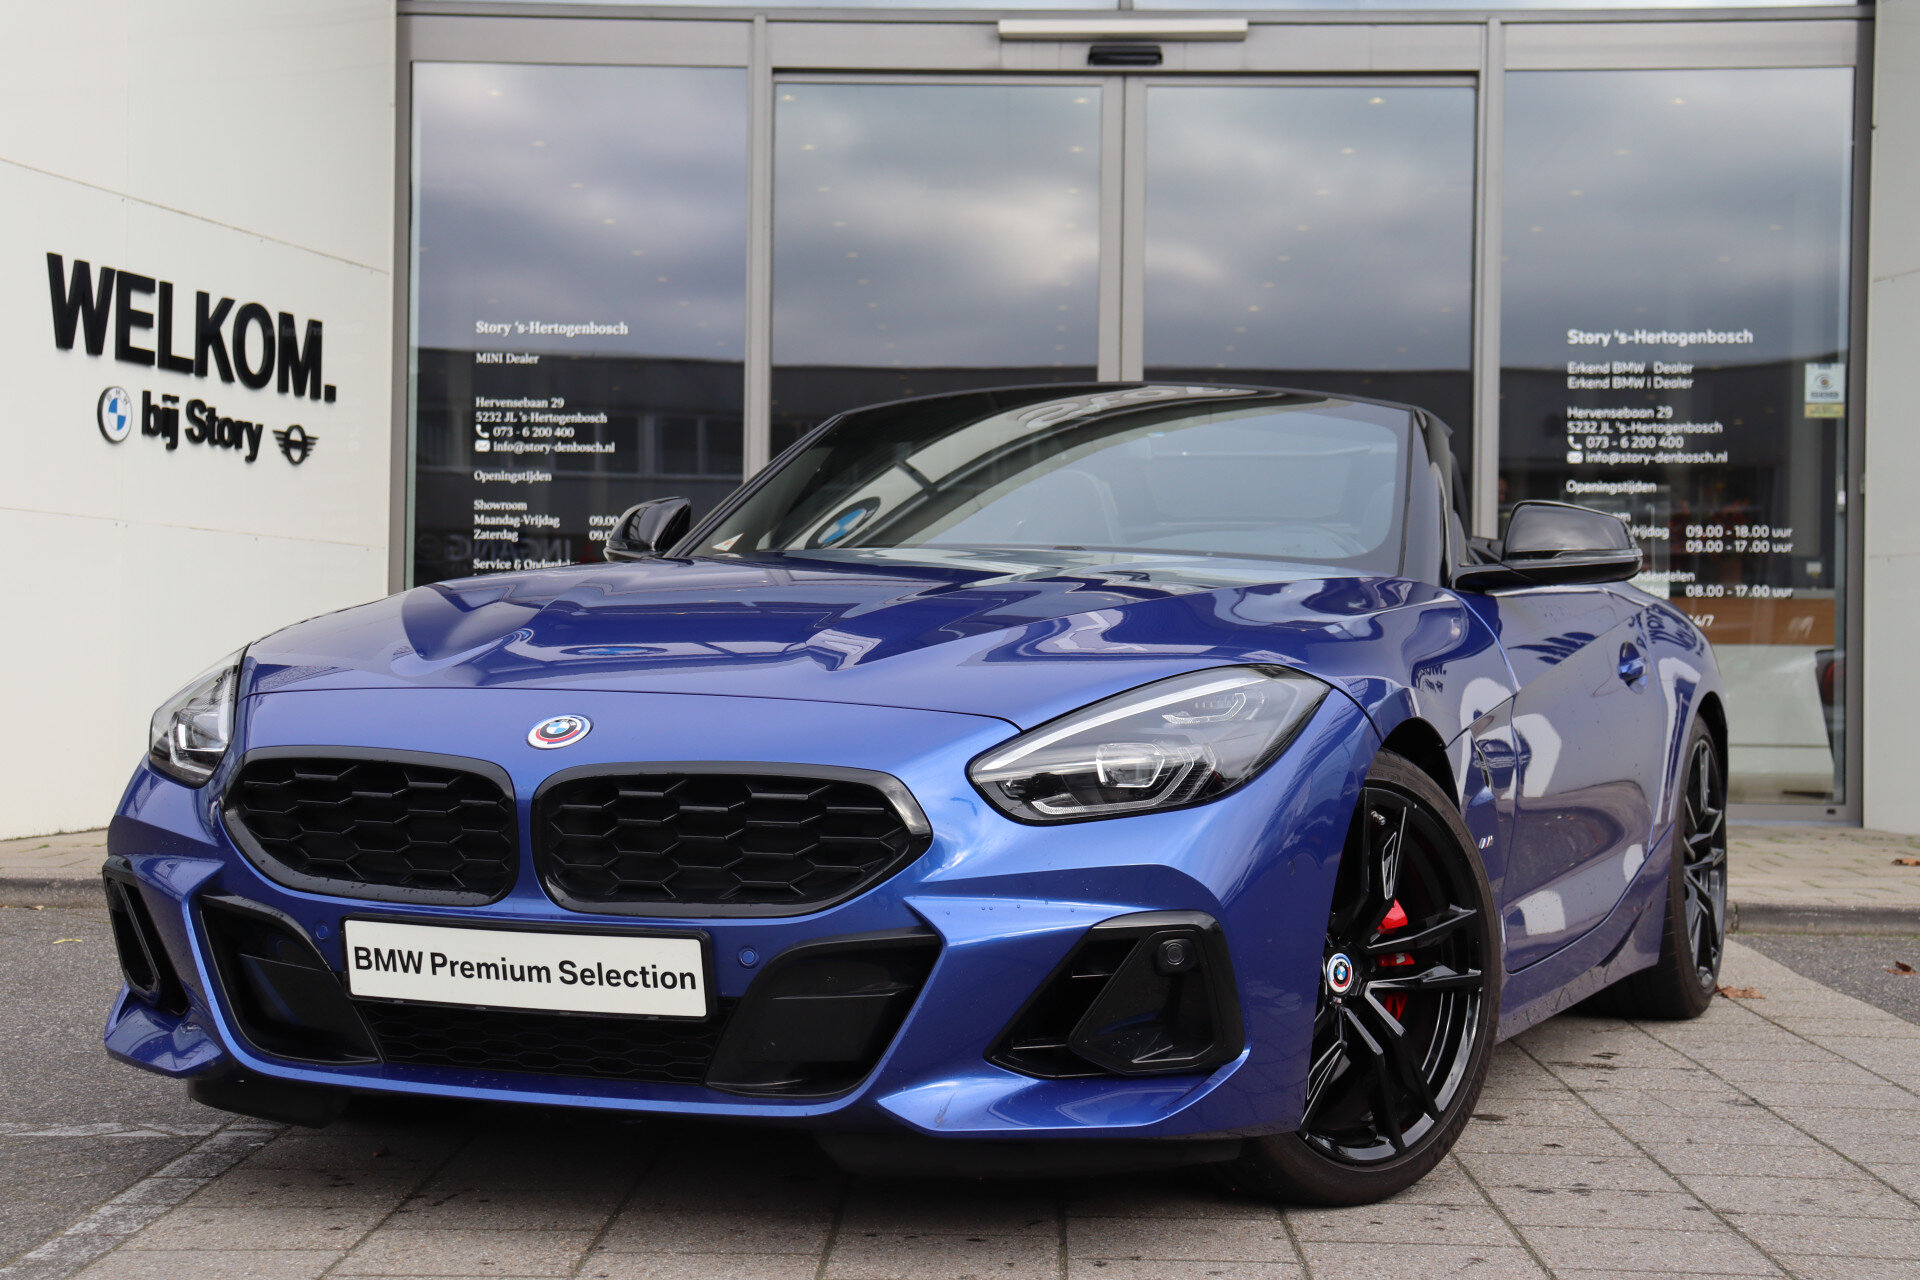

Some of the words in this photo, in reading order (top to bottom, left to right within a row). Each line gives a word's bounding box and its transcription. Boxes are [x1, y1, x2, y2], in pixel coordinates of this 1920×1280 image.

[46, 252, 337, 403] WELKOM.
[475, 320, 512, 337] Story
[1567, 328, 1612, 347] Story
[475, 353, 503, 364] MINI
[505, 353, 540, 364] Dealer
[1567, 361, 1610, 374] Erkend
[1612, 361, 1645, 374] BMW
[1653, 361, 1694, 374] Dealer
[1567, 376, 1610, 389] Erkend
[1612, 376, 1645, 389] BMW
[1653, 376, 1694, 389] Dealer
[475, 397, 549, 409] Hervensebaan
[551, 397, 565, 409] 29
[475, 411, 502, 423] 5232
[503, 412, 517, 423] JL
[1567, 406, 1655, 419] Hervensebaan
[1656, 406, 1673, 419] 29
[141, 390, 180, 452] bij
[184, 398, 264, 464] Story
[493, 427, 514, 438] 073
[522, 427, 530, 438] 6
[532, 427, 553, 438] 200
[554, 427, 575, 438] 400
[1567, 421, 1598, 434] 5232
[1599, 421, 1613, 434] JL
[1586, 436, 1610, 449] 073
[1620, 436, 1629, 449] 6
[1631, 436, 1657, 449] 200
[1658, 436, 1684, 449] 400
[474, 469, 552, 484] Openingstijden
[1566, 479, 1657, 495] Openingstijden
[474, 499, 528, 511] Showroom
[474, 514, 560, 528] Maandag-Vrijdag
[473, 529, 519, 543] Zaterdag
[1685, 524, 1724, 538] 09.00
[1734, 524, 1770, 538] 18.00
[1771, 528, 1793, 538] uur
[1685, 539, 1724, 553] 09.00
[1771, 543, 1793, 553] uur
[473, 558, 512, 570] Service
[513, 559, 522, 571] &
[1685, 584, 1724, 597] 08.00
[1771, 587, 1794, 598] uur
[353, 945, 424, 976] BMW
[429, 951, 552, 984] Premium
[558, 959, 697, 991] Selection
